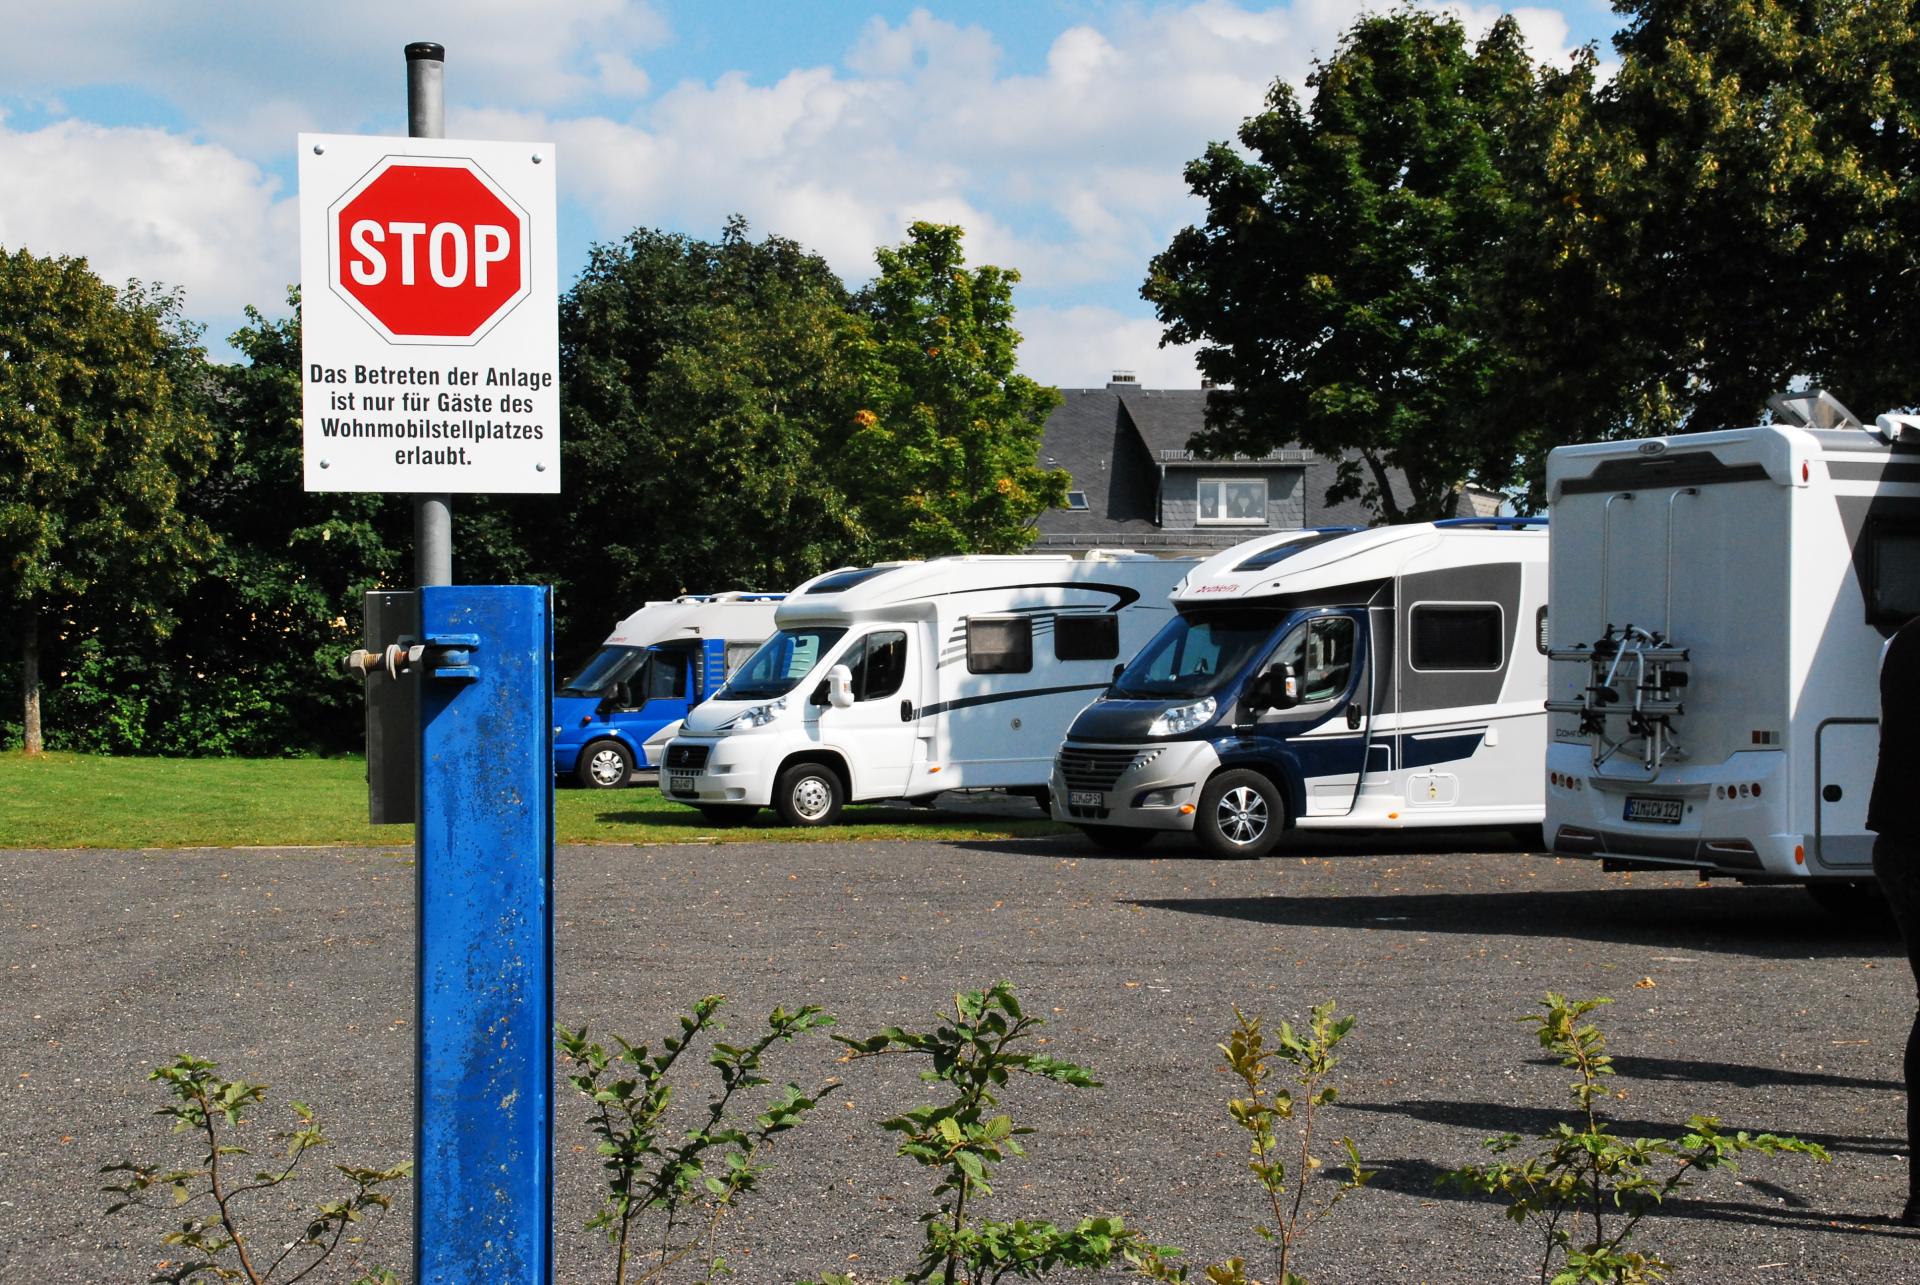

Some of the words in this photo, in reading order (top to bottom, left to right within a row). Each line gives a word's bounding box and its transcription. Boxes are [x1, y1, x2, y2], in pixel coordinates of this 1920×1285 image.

[349, 219, 511, 288] STOP
[310, 363, 347, 384] Das
[354, 364, 440, 386] Betreten
[447, 366, 479, 386] der
[485, 367, 552, 392] Anlage
[331, 391, 355, 411] ist
[363, 396, 395, 411] nur
[402, 392, 430, 412] für
[437, 392, 493, 413] Gäste
[500, 394, 533, 414] des
[321, 417, 543, 444] Wohnmobilstellplatzes
[395, 445, 472, 466] erlaubt.
[1663, 802, 1680, 818] 121
